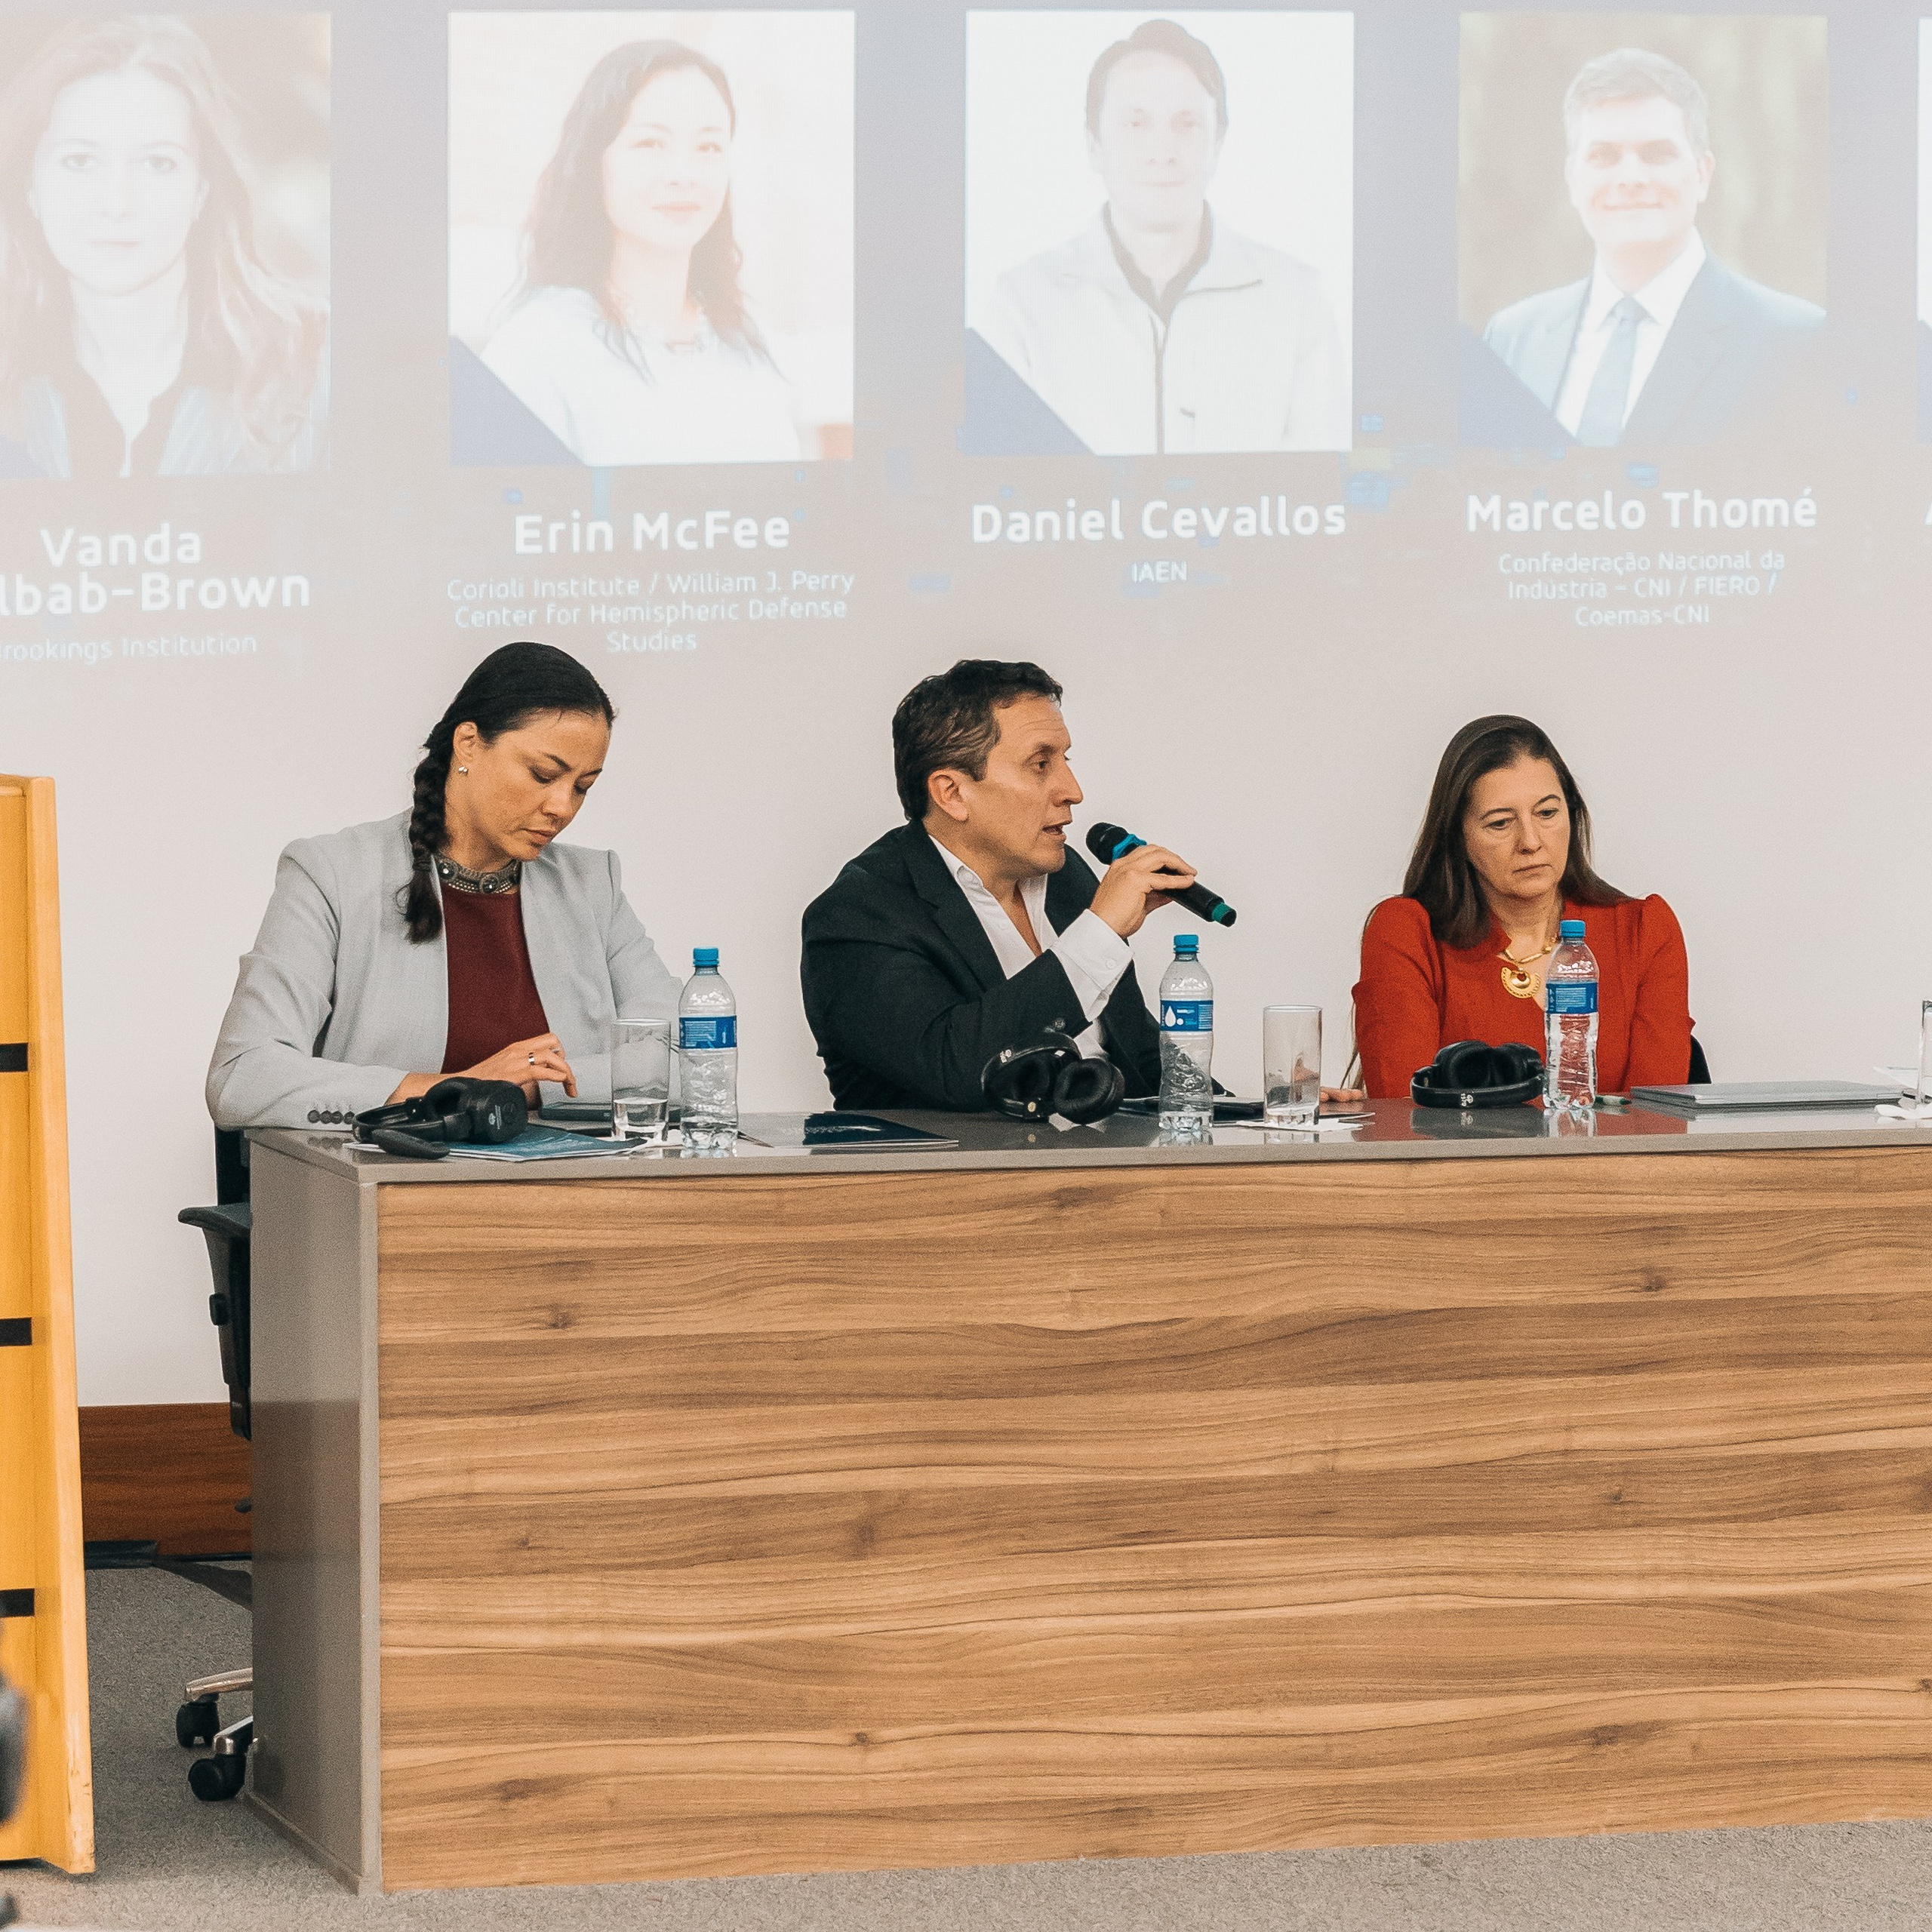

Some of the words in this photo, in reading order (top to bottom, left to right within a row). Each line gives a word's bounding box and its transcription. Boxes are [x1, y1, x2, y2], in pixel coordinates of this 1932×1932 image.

[973, 498, 1124, 543] Daniel
[1141, 495, 1347, 539] Cevallos
[1467, 491, 1647, 531] Marcelo
[1662, 487, 1817, 528] Thomé
[40, 522, 202, 567] Vanda
[515, 509, 614, 555] Erin
[633, 510, 789, 551] McFee
[1132, 561, 1187, 583] IAEN
[1498, 551, 1651, 576] Confederação
[1658, 550, 1752, 571] Nacional
[1759, 549, 1786, 571] da
[447, 576, 525, 601] Corioli
[534, 576, 639, 598] Institute
[666, 571, 756, 593] William
[766, 571, 781, 592] J.
[792, 571, 855, 595] Perry
[1508, 578, 1607, 600] Indústria
[1635, 577, 1671, 598] CNI
[1695, 575, 1761, 595] FIERO
[454, 605, 537, 629] Center
[546, 602, 581, 625] for
[589, 599, 739, 627] Hemispheric
[749, 596, 846, 620] Defense
[1574, 605, 1709, 627] Coemas-CNI
[0, 638, 112, 665] rookings
[122, 632, 257, 658] Institution
[607, 629, 697, 653] Studies
